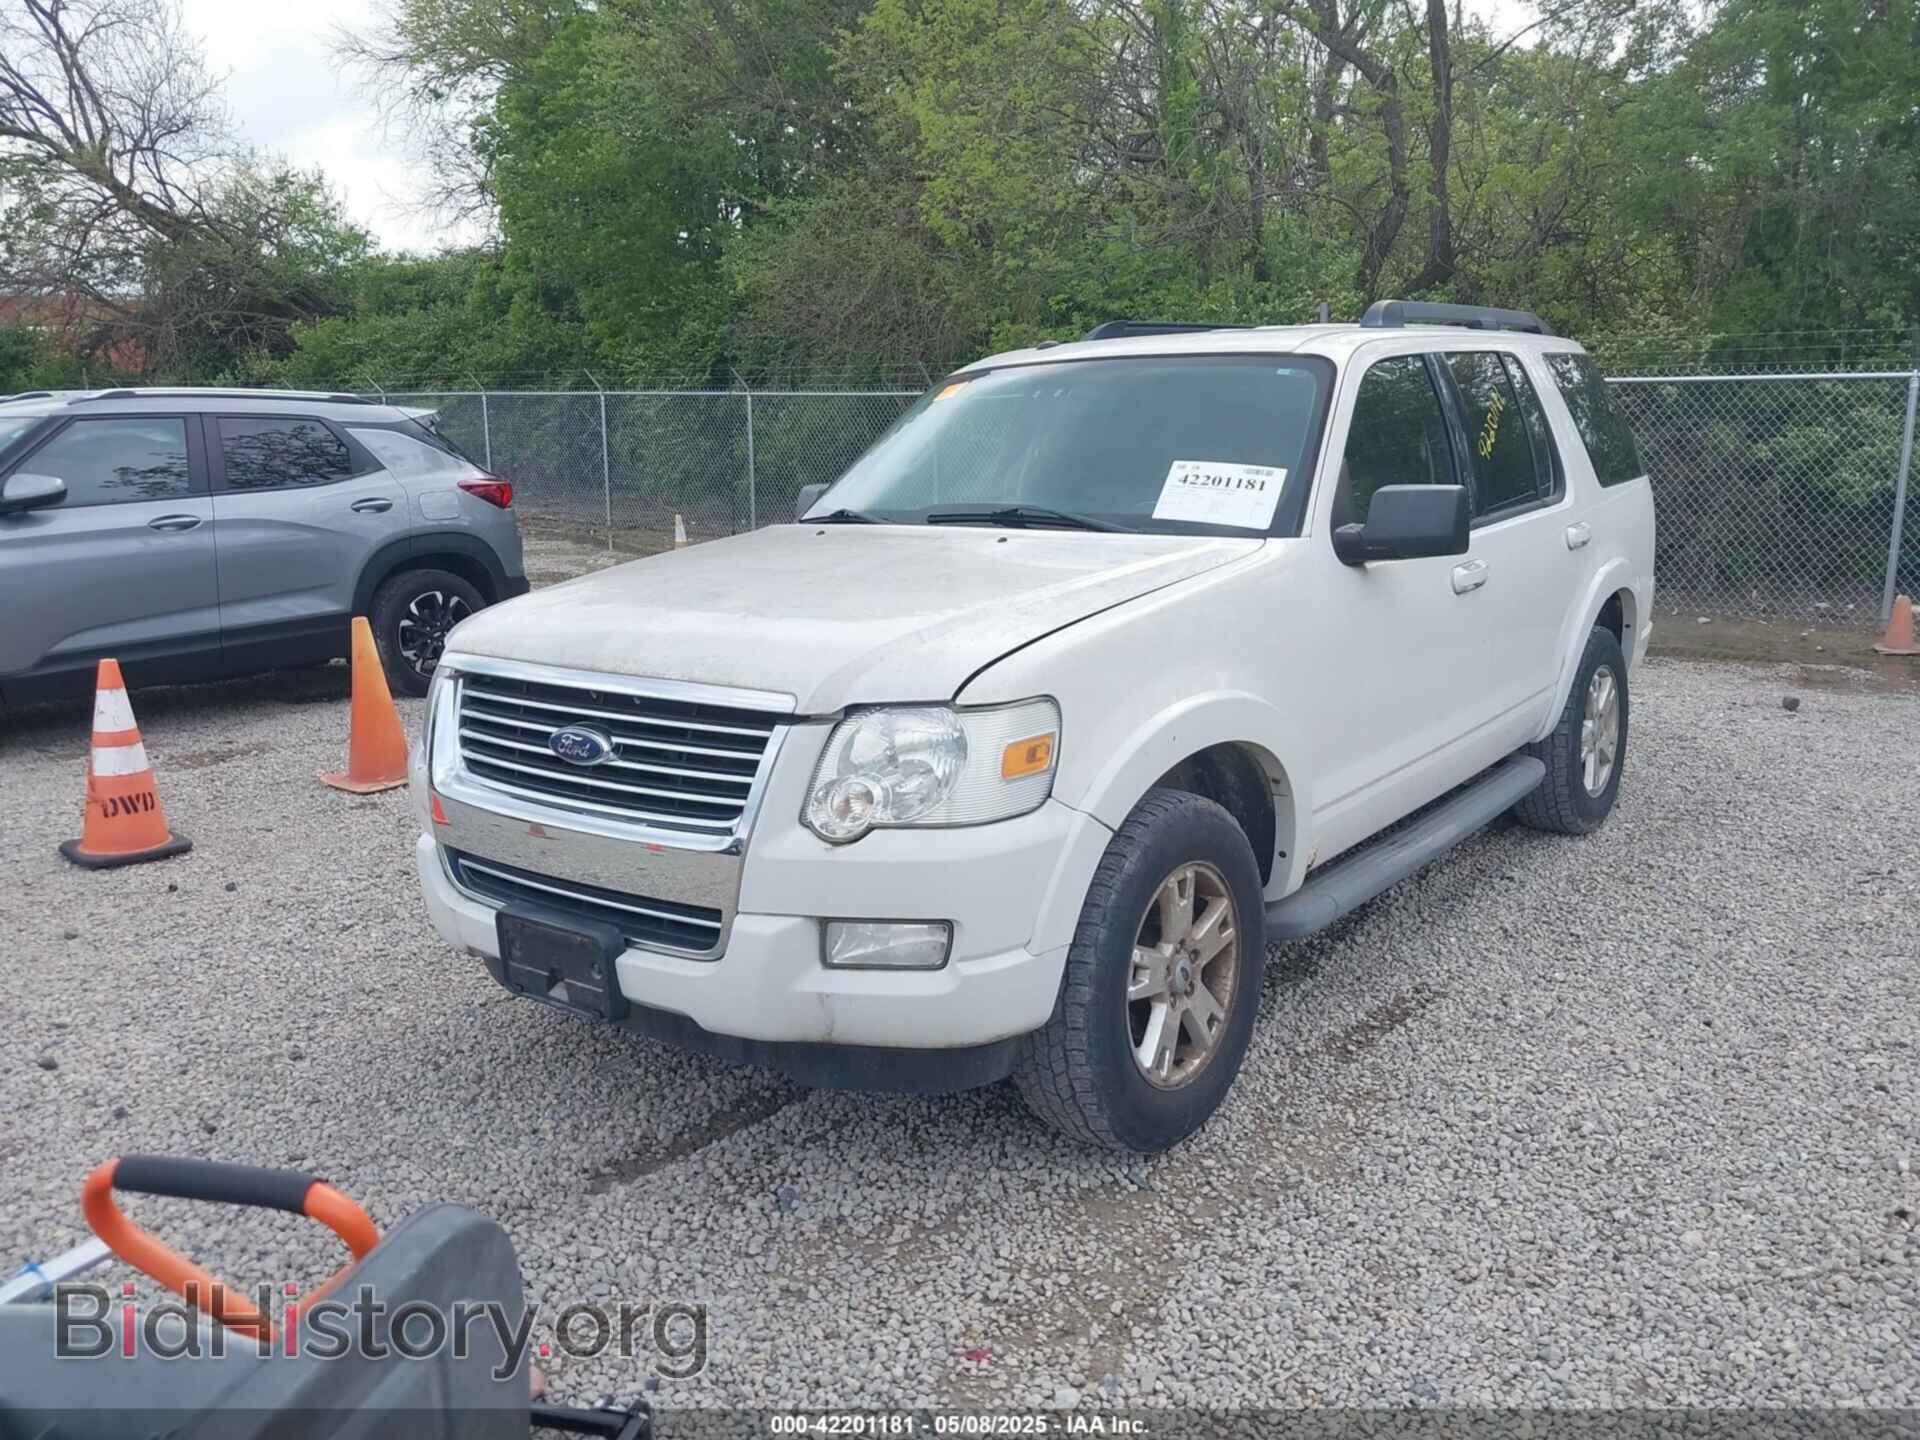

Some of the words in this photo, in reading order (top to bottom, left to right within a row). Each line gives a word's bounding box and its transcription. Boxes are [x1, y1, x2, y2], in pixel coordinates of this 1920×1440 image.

[1178, 473, 1266, 492] 42201181
[558, 733, 590, 758] Ford
[103, 792, 155, 818] DWD
